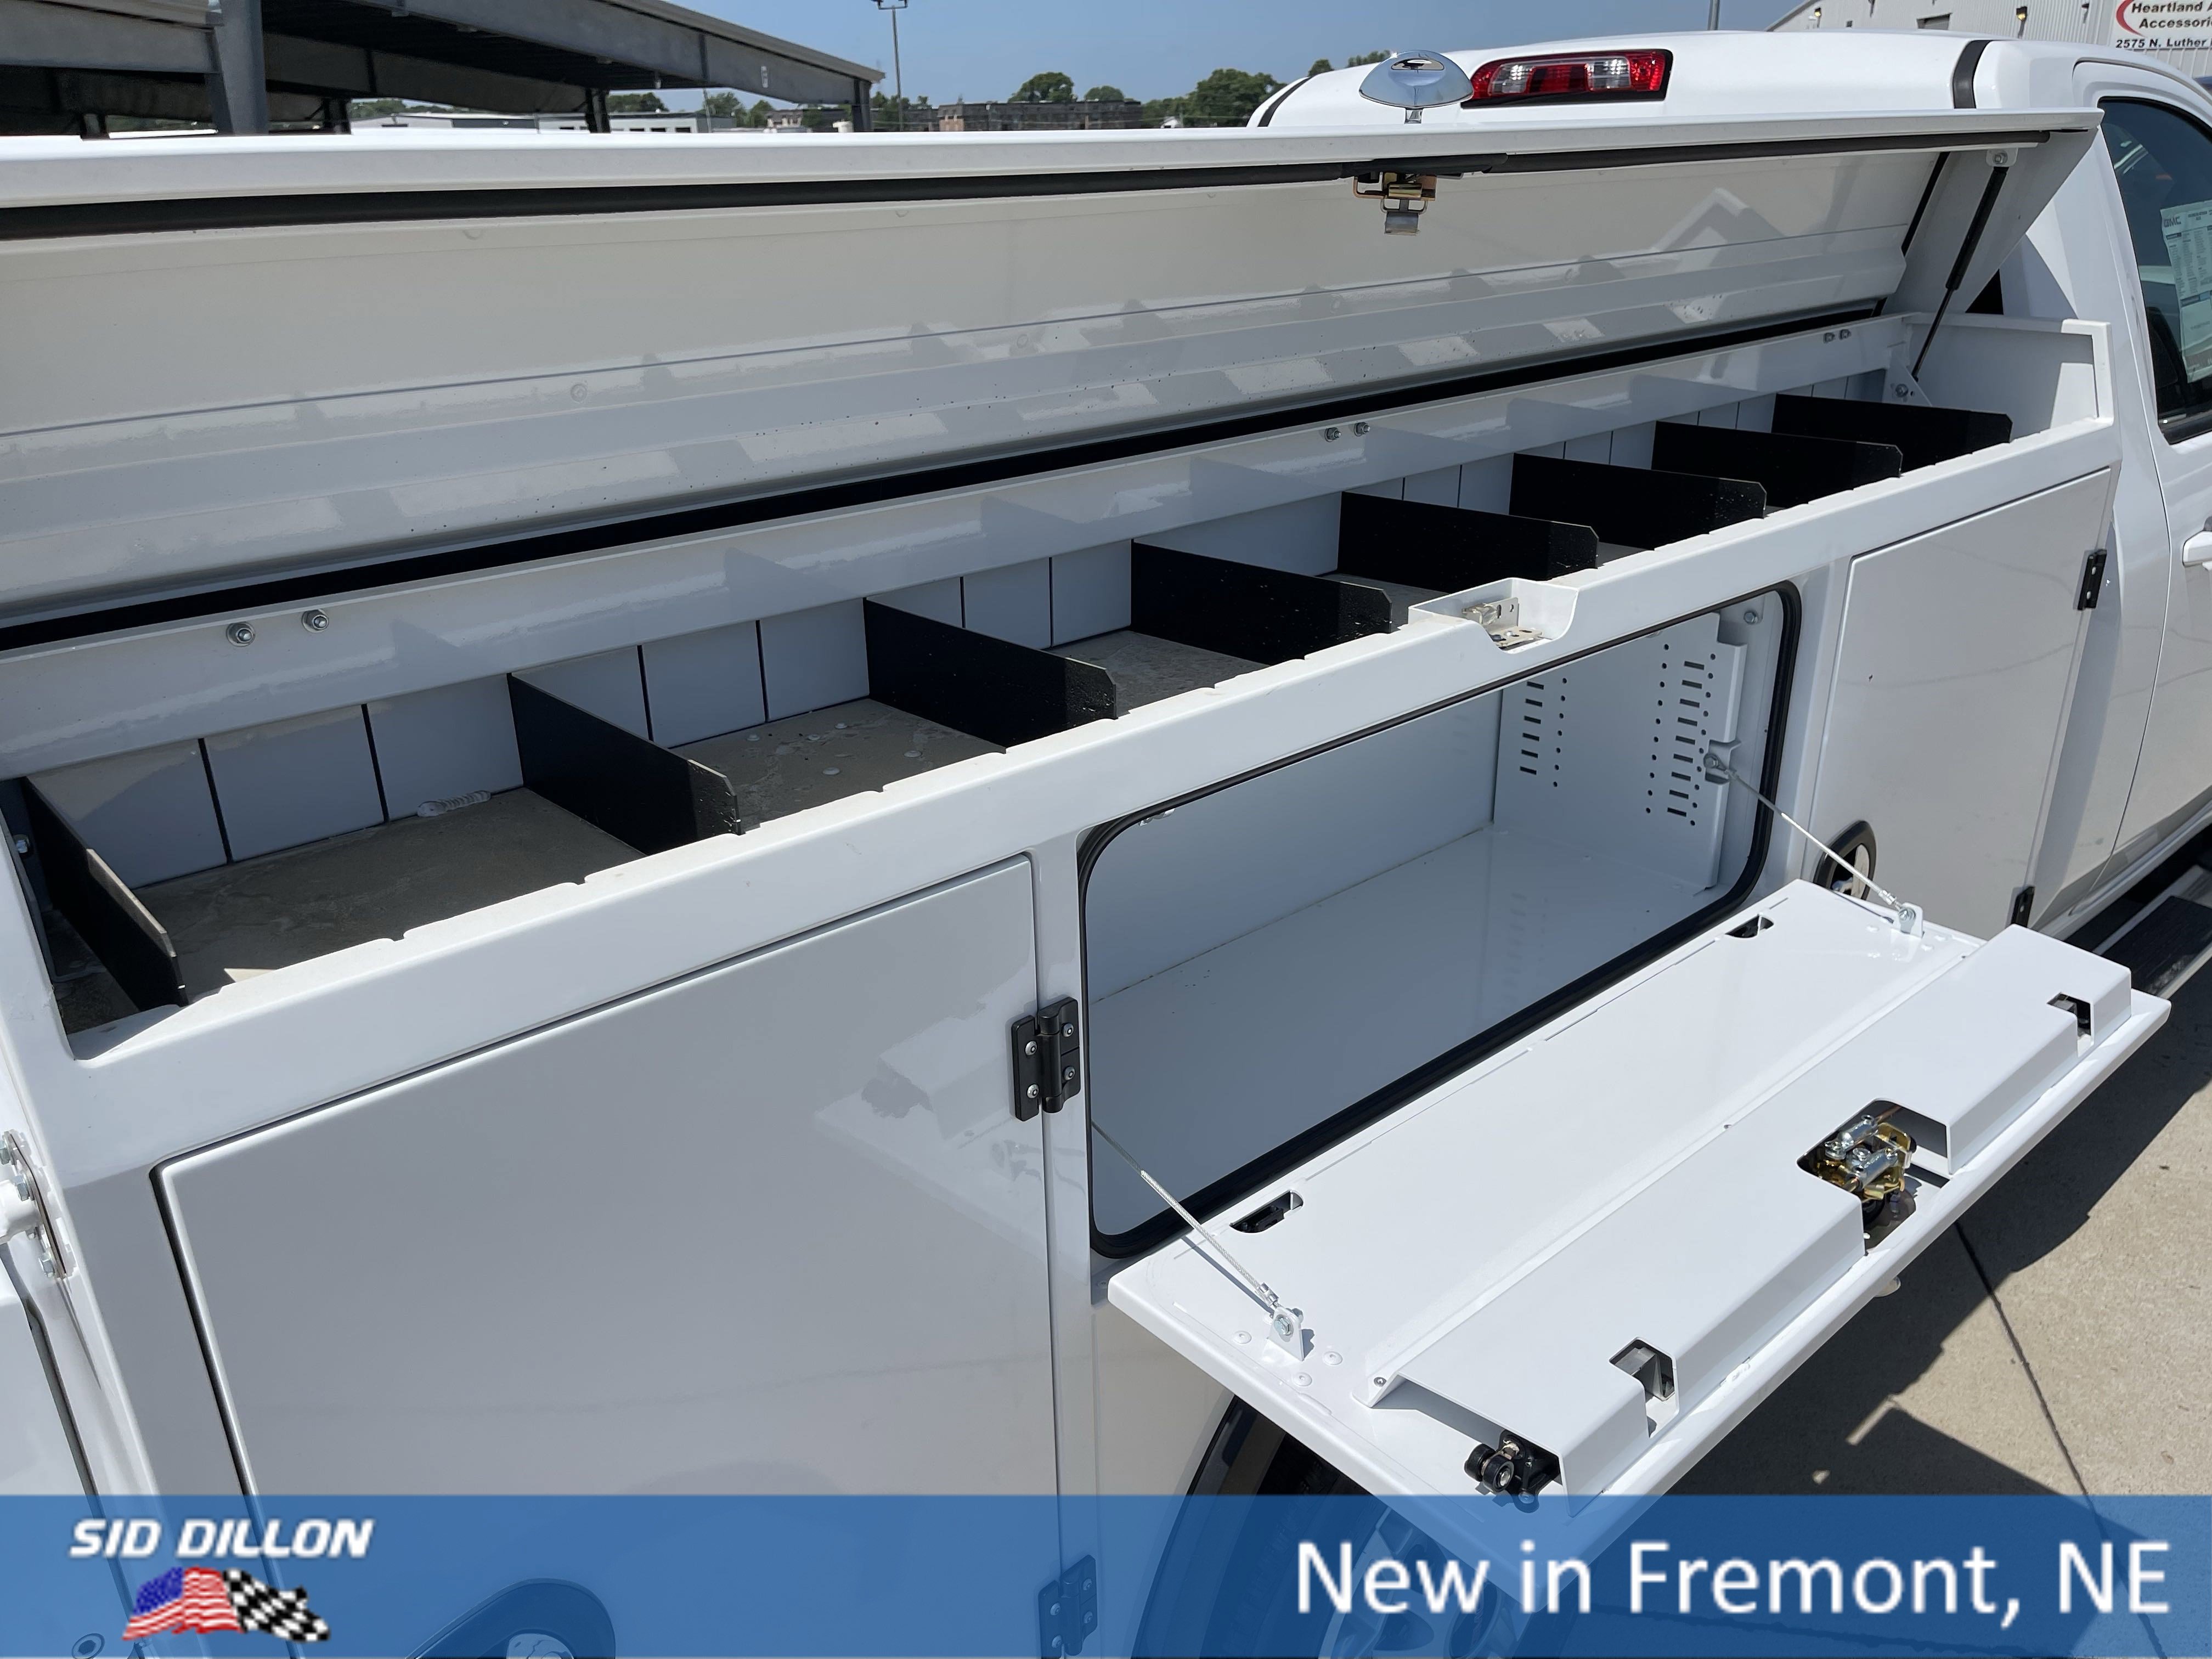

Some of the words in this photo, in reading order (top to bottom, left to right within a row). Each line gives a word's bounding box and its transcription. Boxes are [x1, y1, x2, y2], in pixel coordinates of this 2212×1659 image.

[2131, 2, 2203, 13] Heartland
[2139, 16, 2212, 28] Accessori
[2116, 39, 2145, 48] 2575
[2149, 38, 2162, 47] N.
[2166, 38, 2208, 47] Luther
[2164, 216, 2181, 228] GMC
